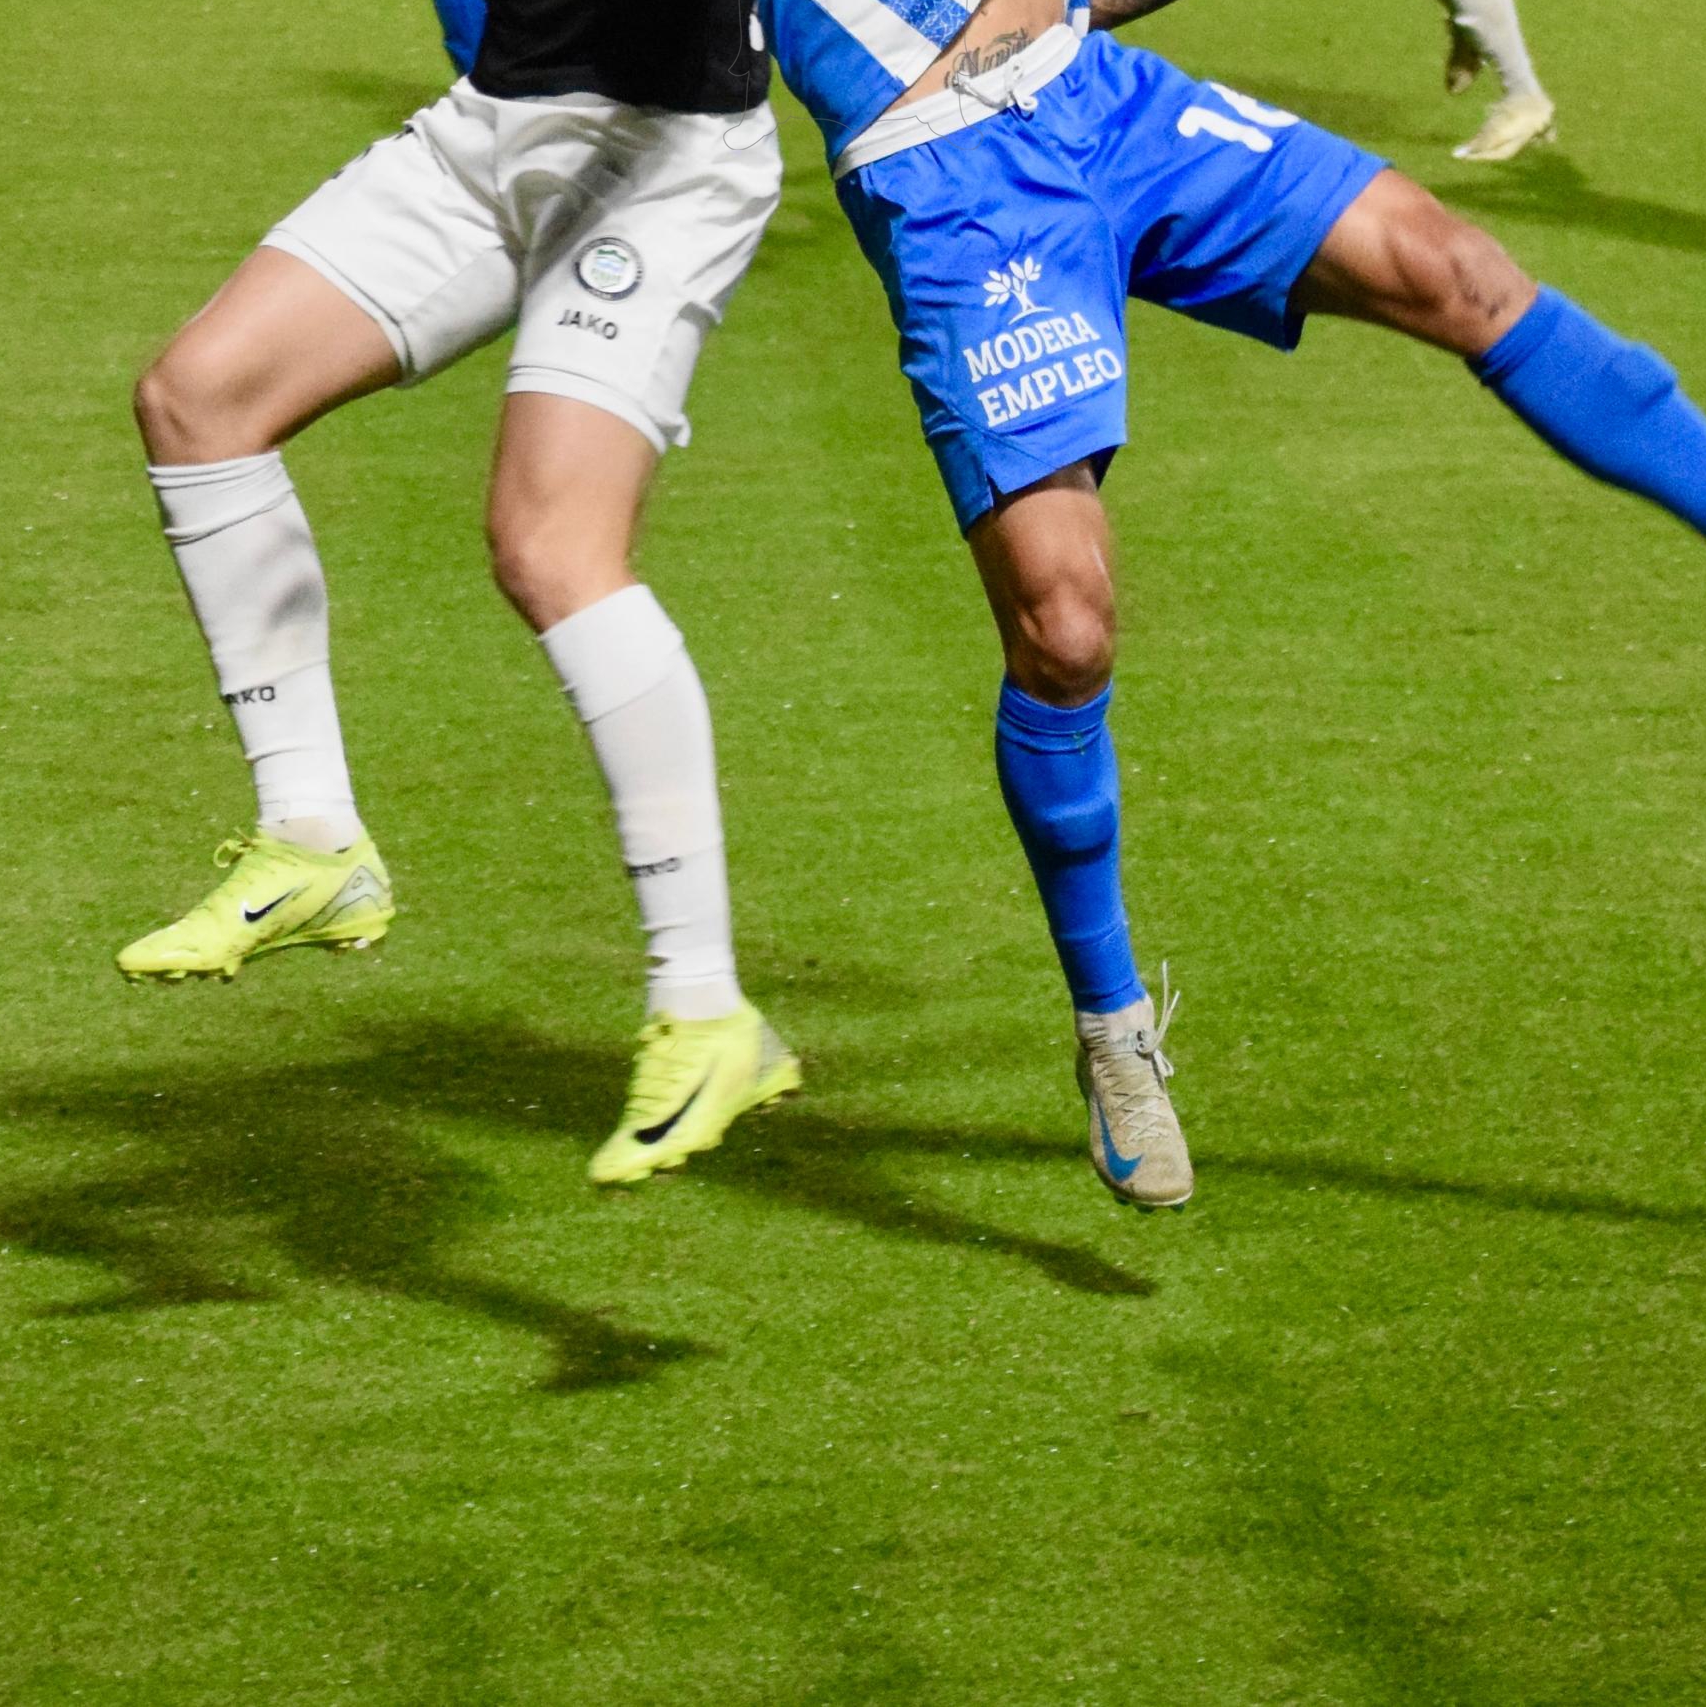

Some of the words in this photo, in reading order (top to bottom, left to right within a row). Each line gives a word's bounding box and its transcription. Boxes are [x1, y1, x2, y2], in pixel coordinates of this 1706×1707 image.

[558, 308, 619, 341] JAKO
[963, 312, 1101, 384] MODERA
[976, 347, 1124, 428] EMPLEO
